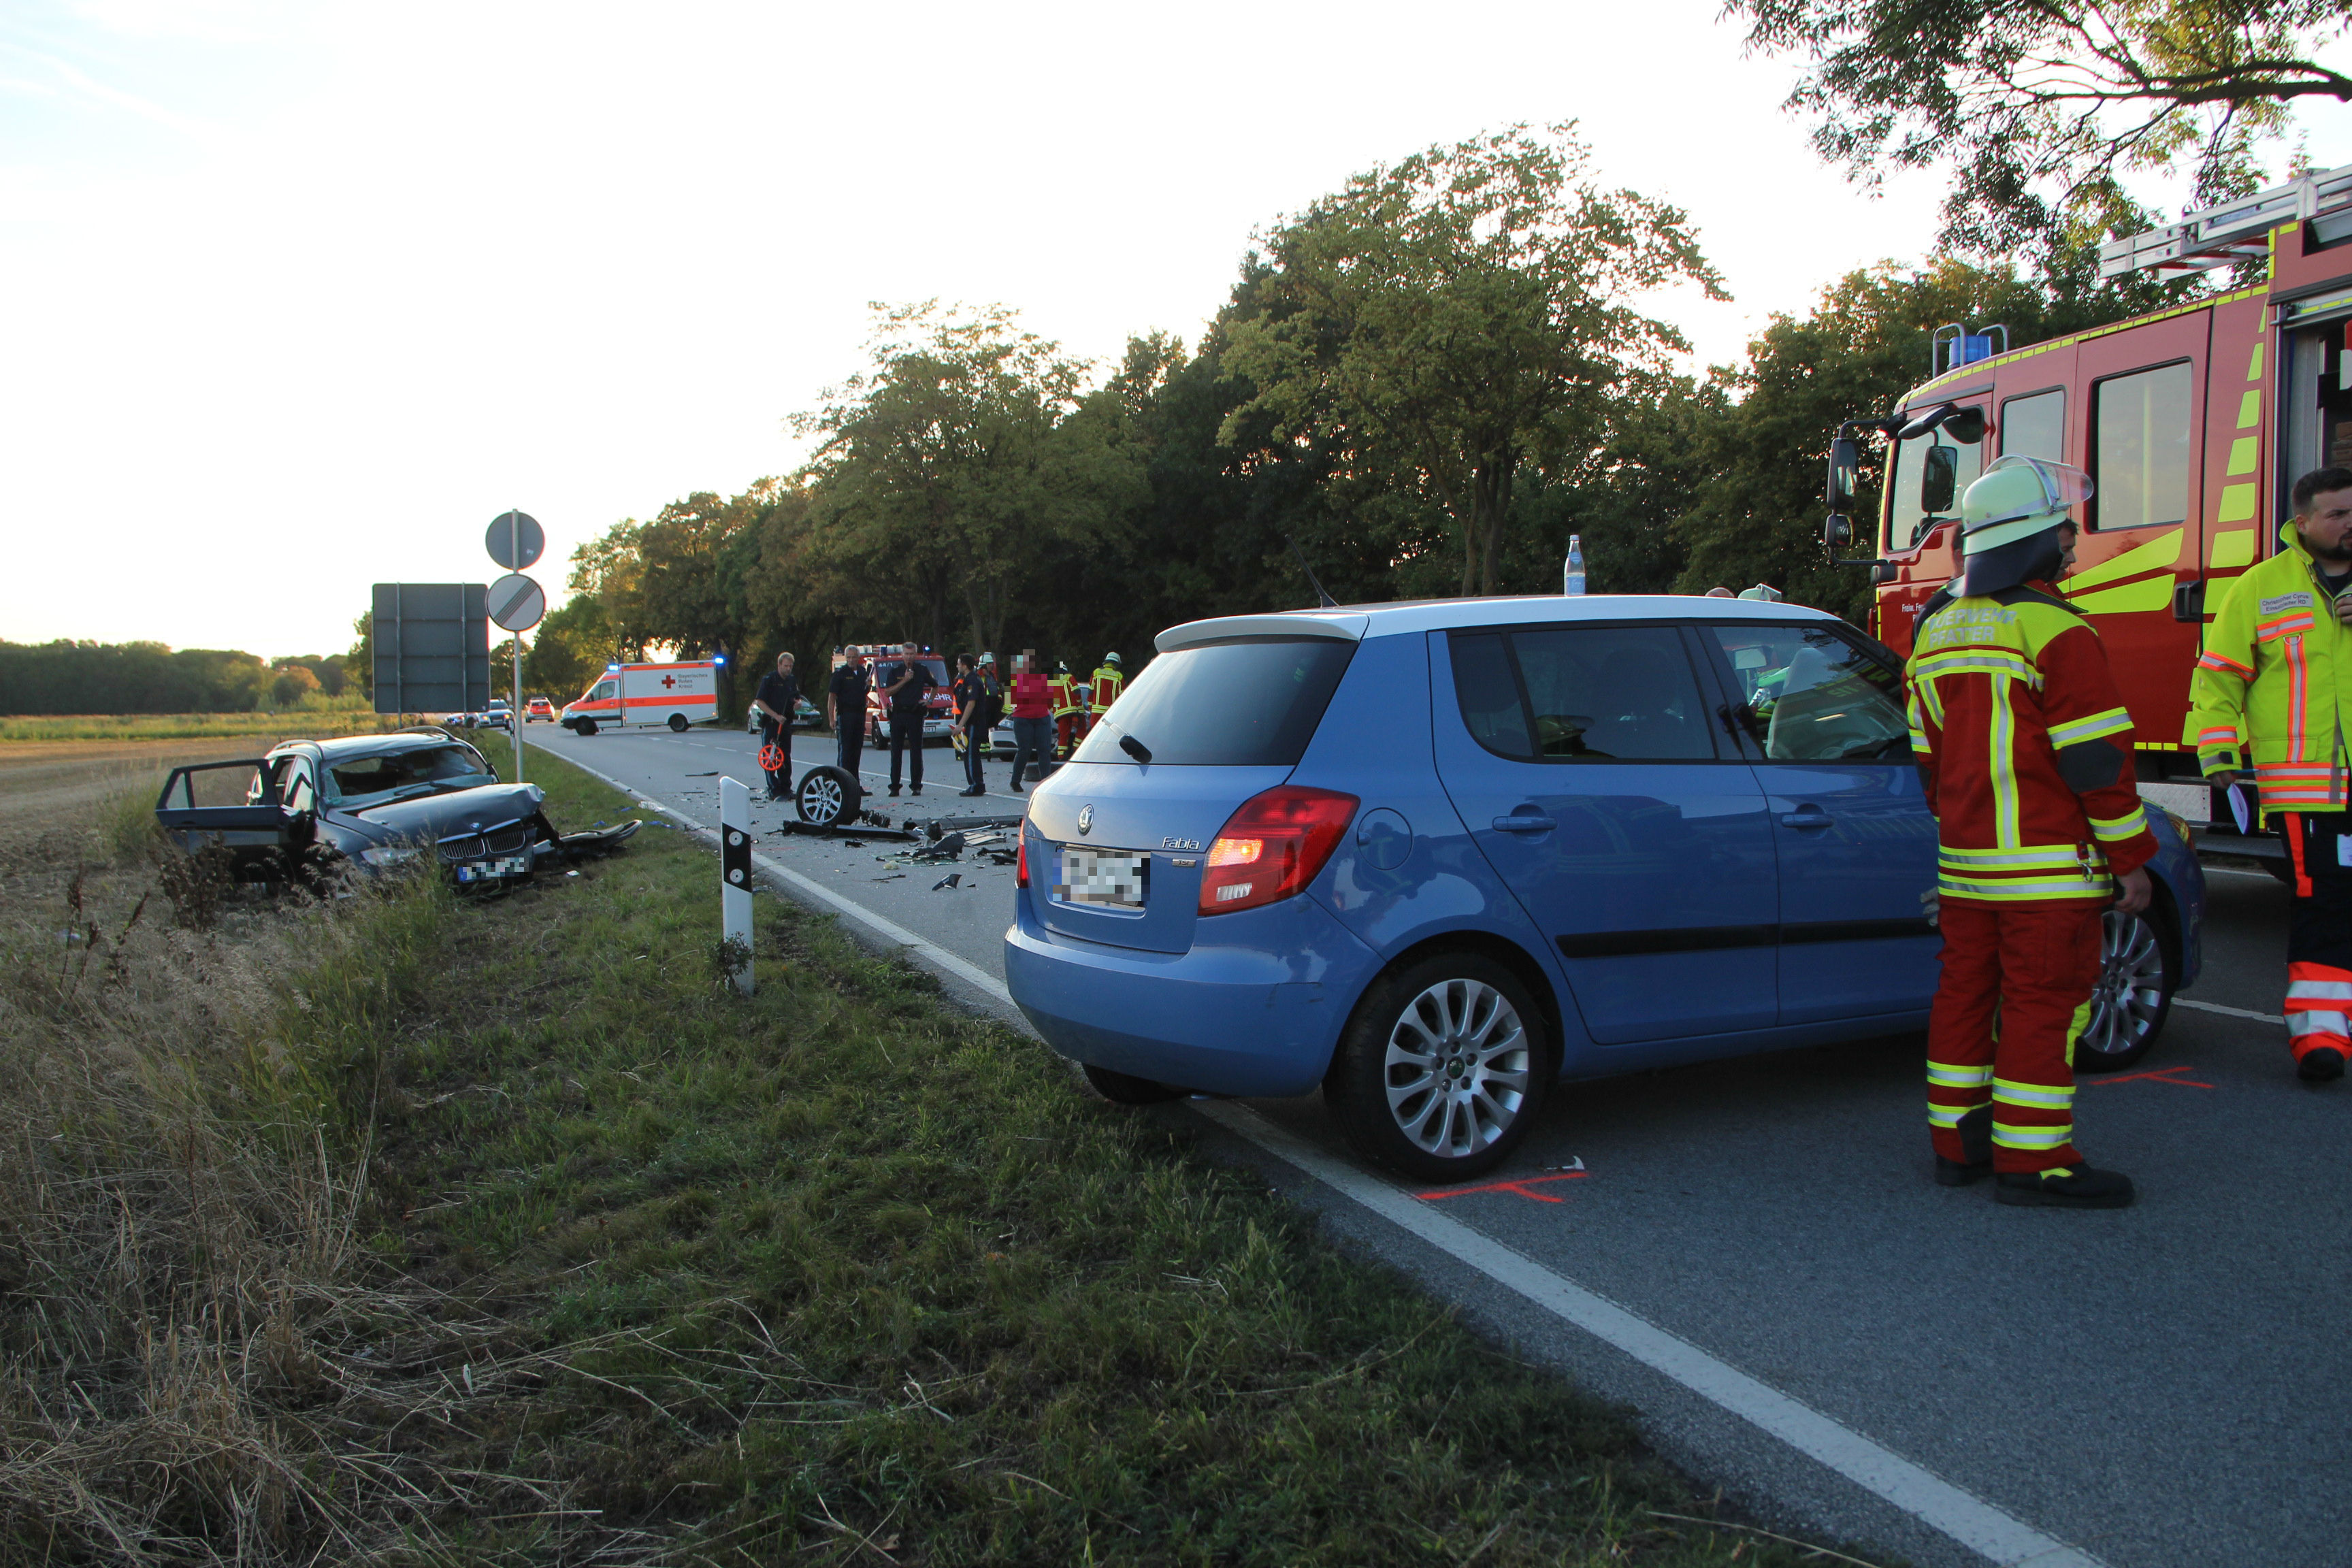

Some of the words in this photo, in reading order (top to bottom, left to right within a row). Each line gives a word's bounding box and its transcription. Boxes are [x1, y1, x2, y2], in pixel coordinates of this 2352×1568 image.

[1928, 607, 2017, 632] FEUERWEHR
[1929, 625, 1995, 648] PFATTER
[1162, 836, 1200, 850] Fabia
